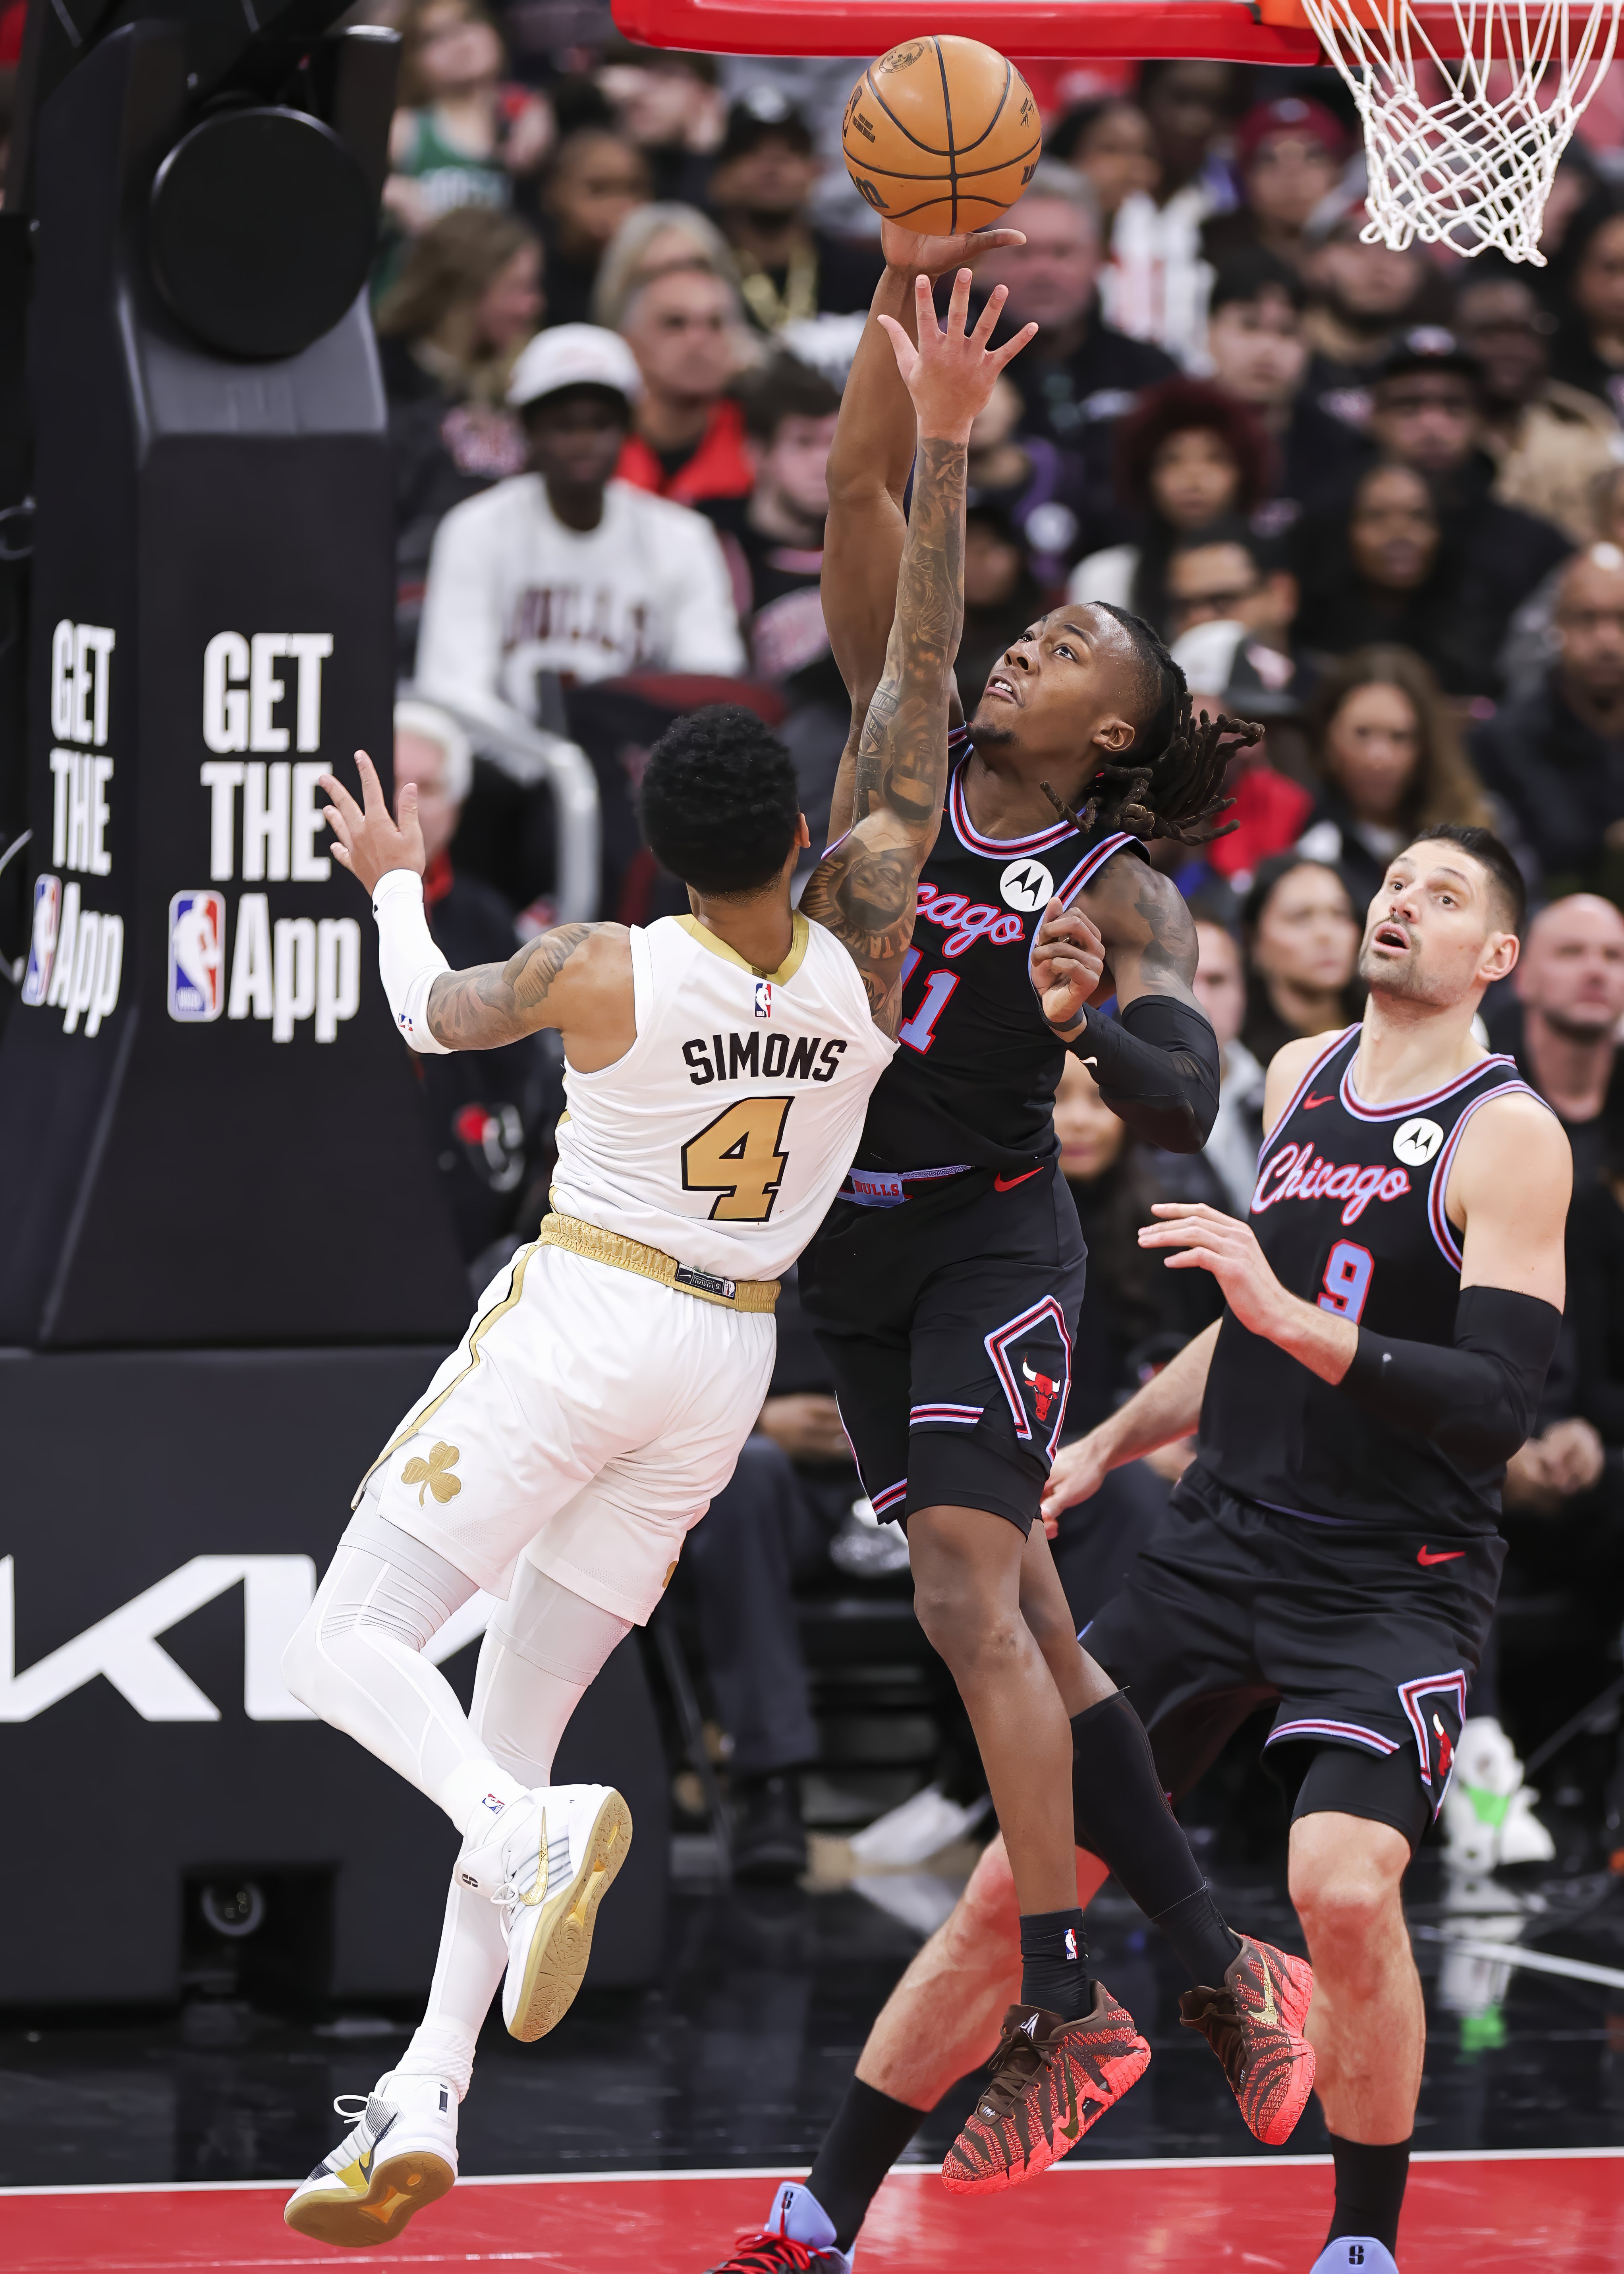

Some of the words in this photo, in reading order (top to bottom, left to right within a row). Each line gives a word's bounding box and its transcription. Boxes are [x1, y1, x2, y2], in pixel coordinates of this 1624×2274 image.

[51, 619, 116, 746] GET
[203, 631, 333, 753] GET
[50, 748, 114, 875] THE
[200, 762, 332, 881] THE
[46, 882, 124, 1038] App
[228, 893, 361, 1043] App
[915, 883, 1025, 958] cago
[682, 1032, 847, 1086] SIMONS
[681, 1096, 795, 1222] 4
[1251, 1142, 1412, 1225] Chicago
[1317, 1238, 1375, 1325] 9
[0, 1551, 496, 1723] KI
